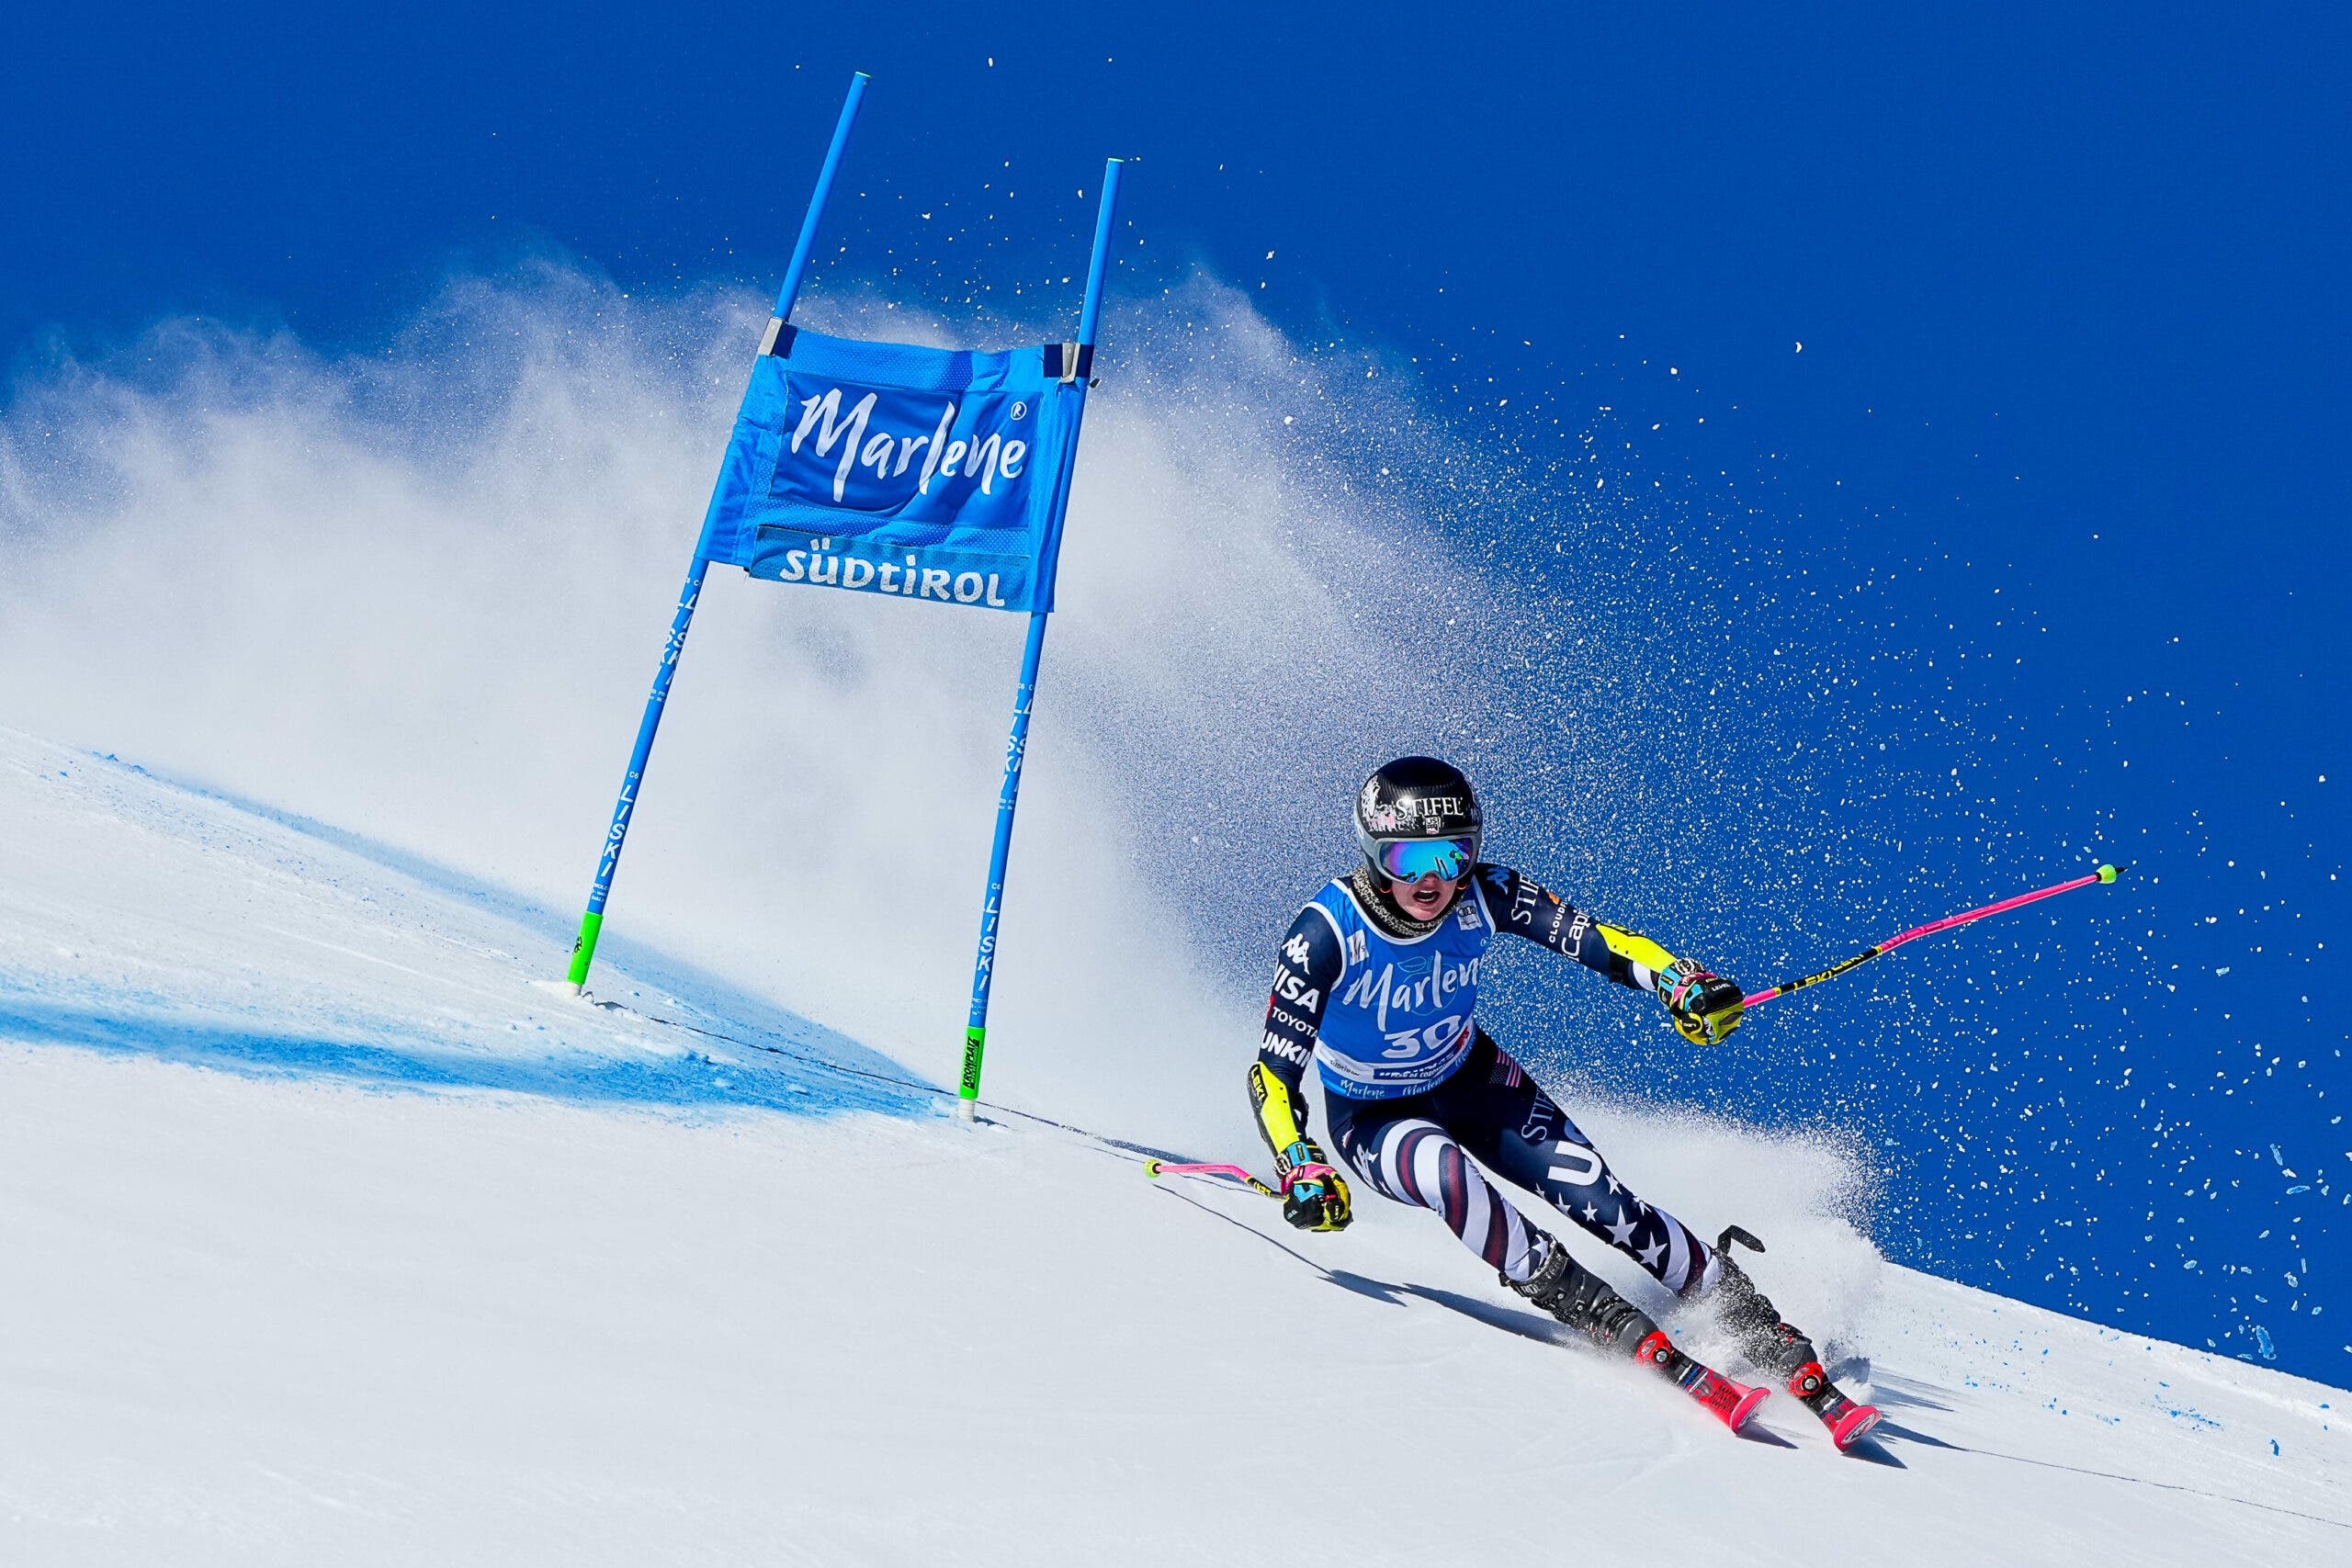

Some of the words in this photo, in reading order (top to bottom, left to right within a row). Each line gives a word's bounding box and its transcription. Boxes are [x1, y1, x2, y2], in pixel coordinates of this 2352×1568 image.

[792, 388, 1027, 502] Marlene
[628, 771, 639, 779] C6
[1396, 796, 1464, 820] STIFEL
[600, 784, 634, 877] LISKI
[977, 897, 999, 991] LISKI
[1341, 950, 1485, 1032] Marlen
[1792, 970, 1832, 990] LEKI
[1381, 1015, 1462, 1058] 30
[1250, 1066, 1266, 1100] LEKI
[1340, 1079, 1385, 1099] Marlene
[1254, 1181, 1272, 1198] LEKI
